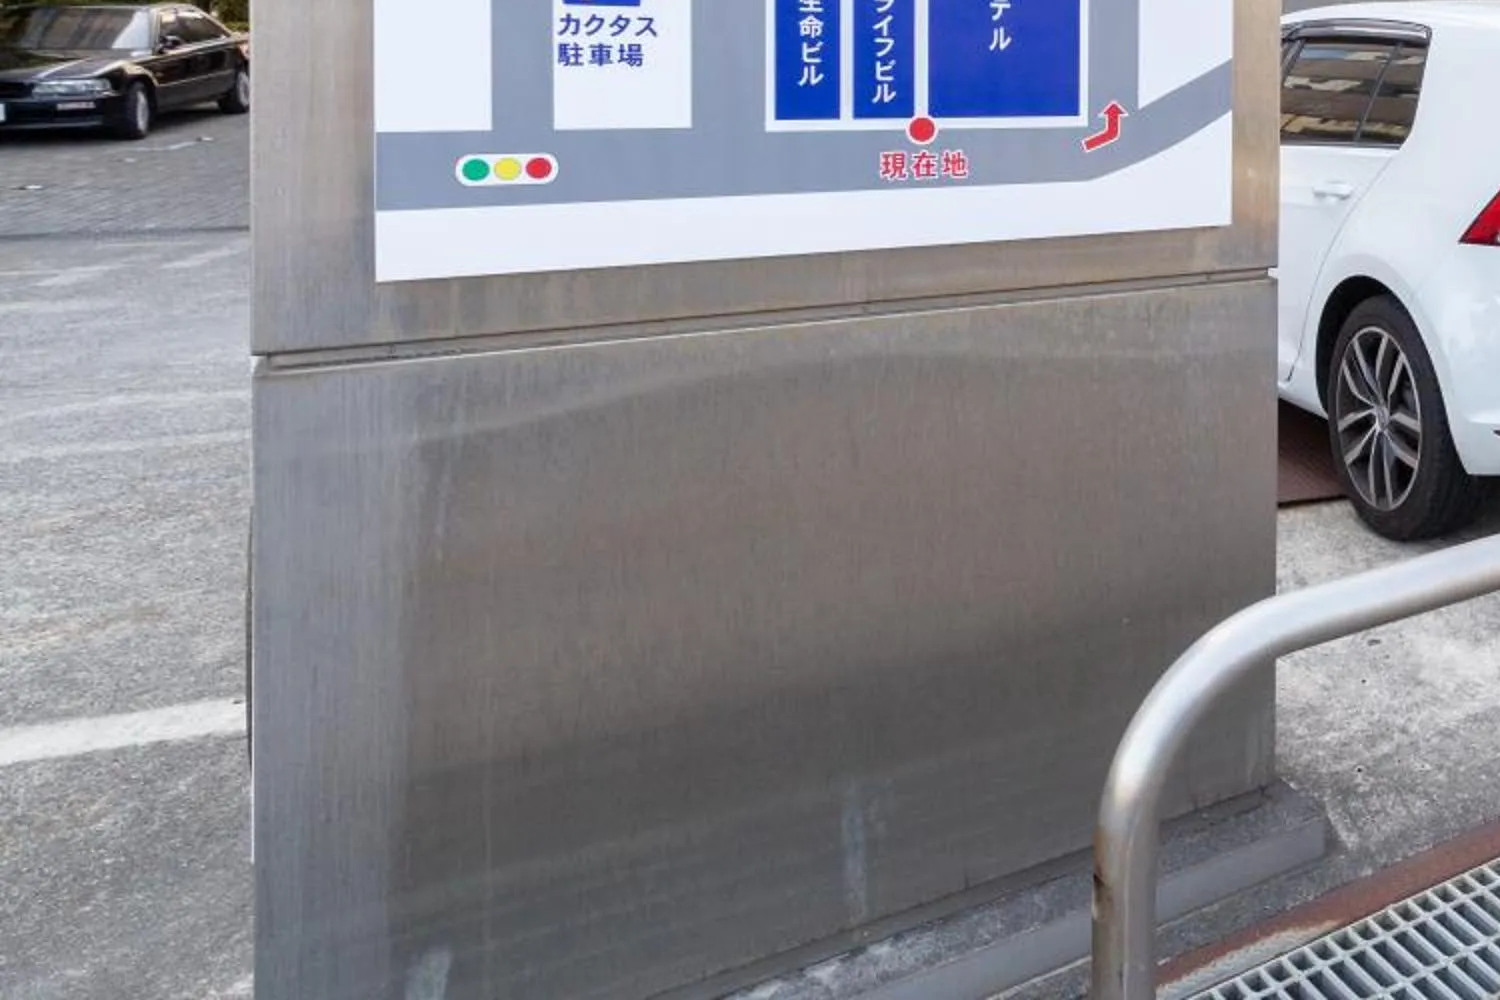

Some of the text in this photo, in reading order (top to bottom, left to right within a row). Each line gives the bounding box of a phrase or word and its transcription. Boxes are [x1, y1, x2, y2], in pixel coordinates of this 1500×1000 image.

[558, 13, 658, 37] カクタス
[558, 42, 644, 68] 駐車場
[881, 151, 968, 179] 現在地
